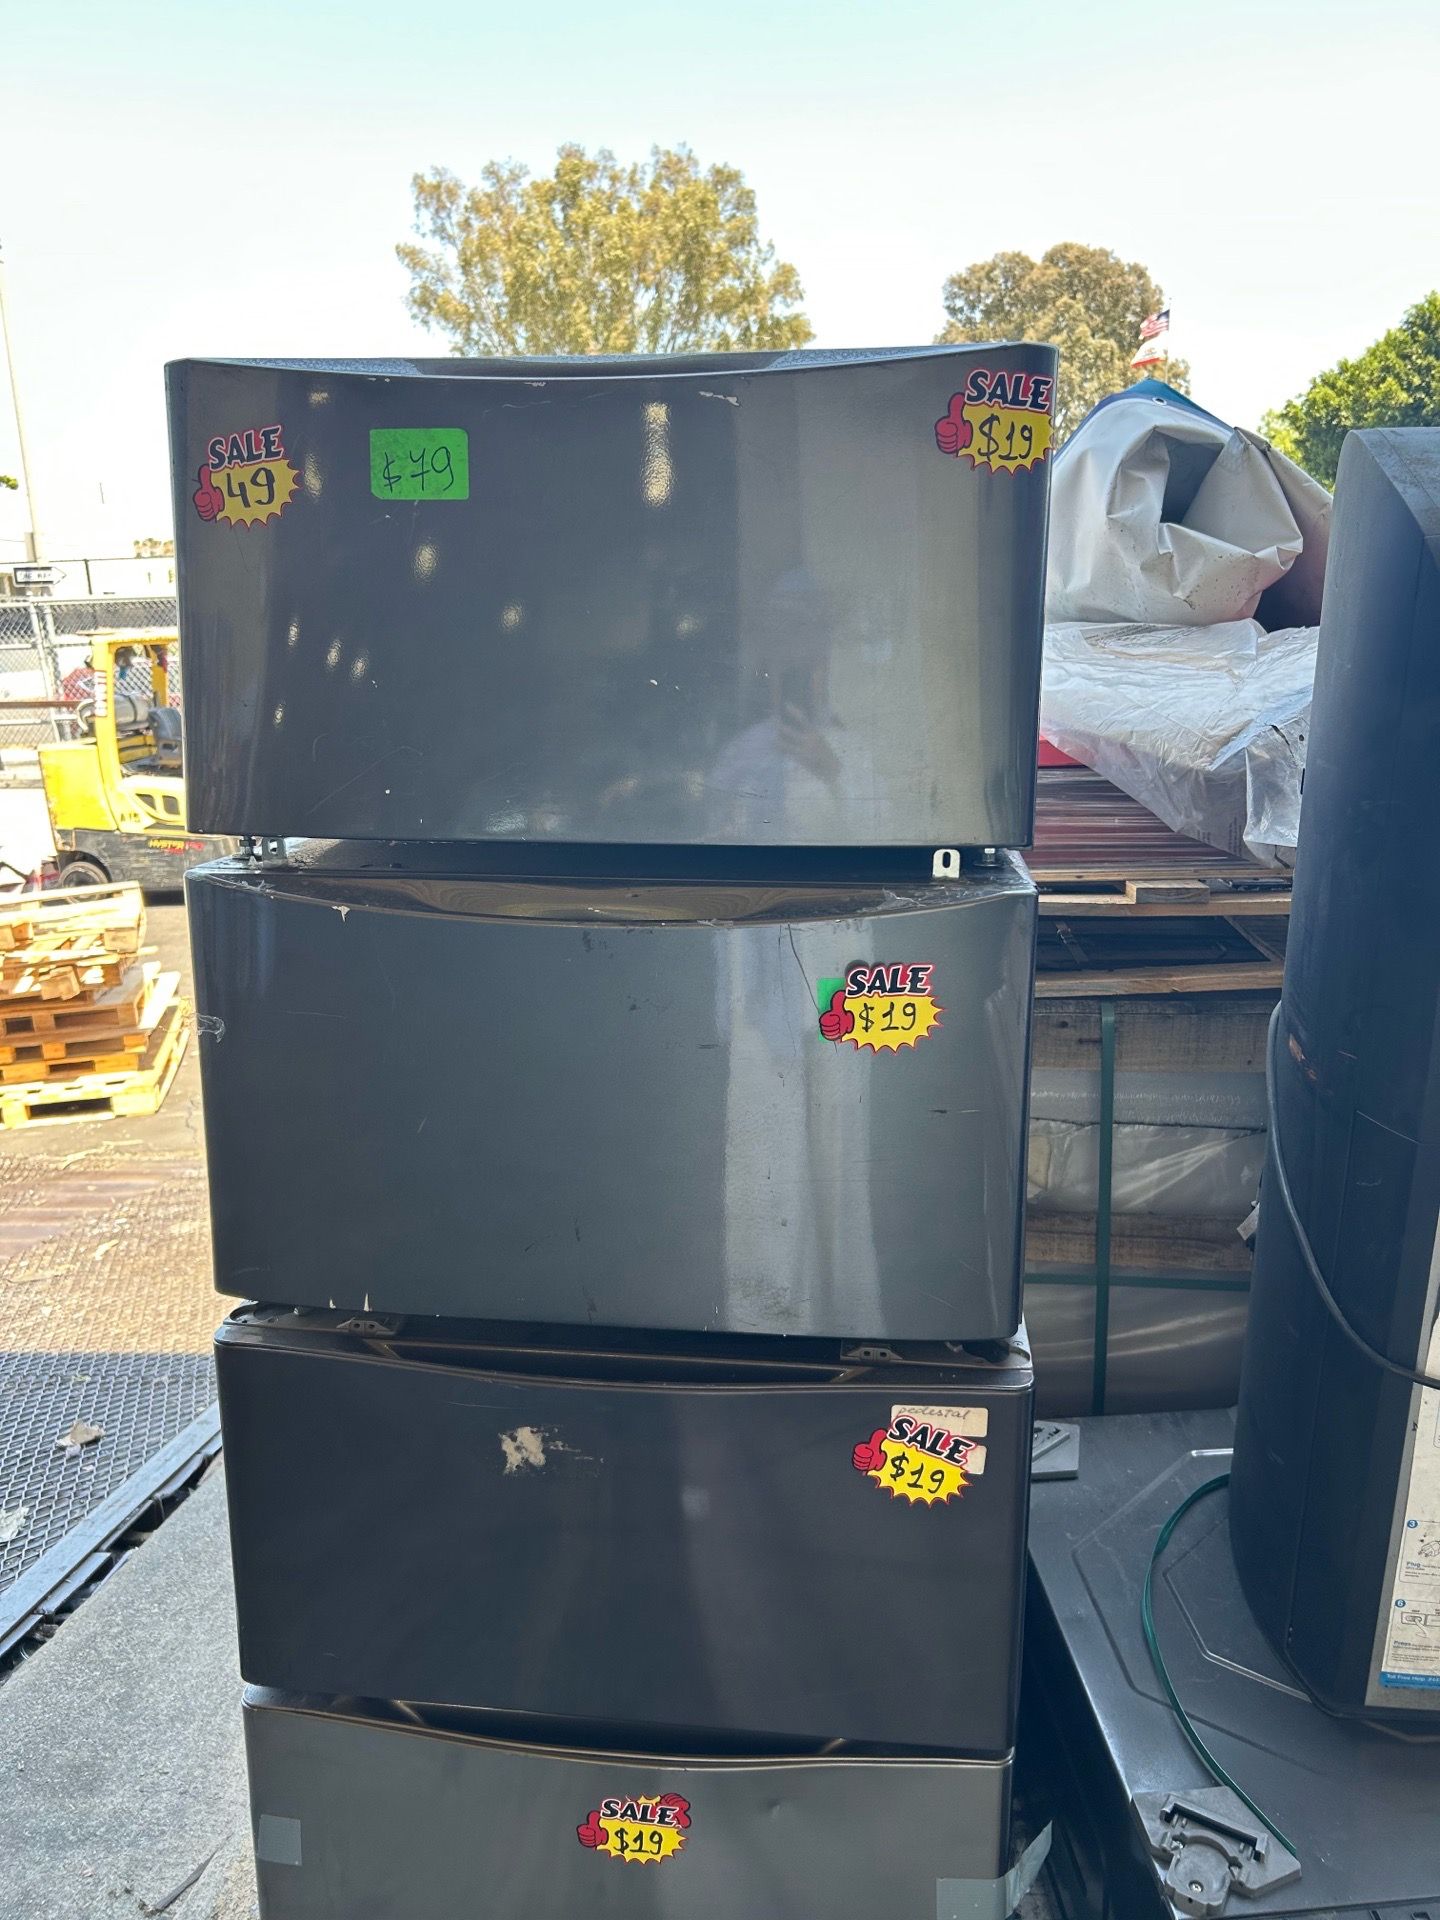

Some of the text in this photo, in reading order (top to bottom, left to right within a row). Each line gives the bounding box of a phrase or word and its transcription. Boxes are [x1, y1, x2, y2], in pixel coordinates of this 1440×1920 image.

[964, 369, 1052, 412] SALE
[208, 424, 284, 471] SALE
[977, 413, 1033, 462] $19
[225, 467, 275, 508] 49
[845, 964, 933, 997] SALE
[858, 1001, 917, 1032] $19
[897, 1406, 971, 1420] pedestal
[887, 1416, 976, 1467] SALE
[889, 1451, 945, 1494] $19
[601, 1798, 679, 1827] SALE
[613, 1827, 664, 1855] $19
